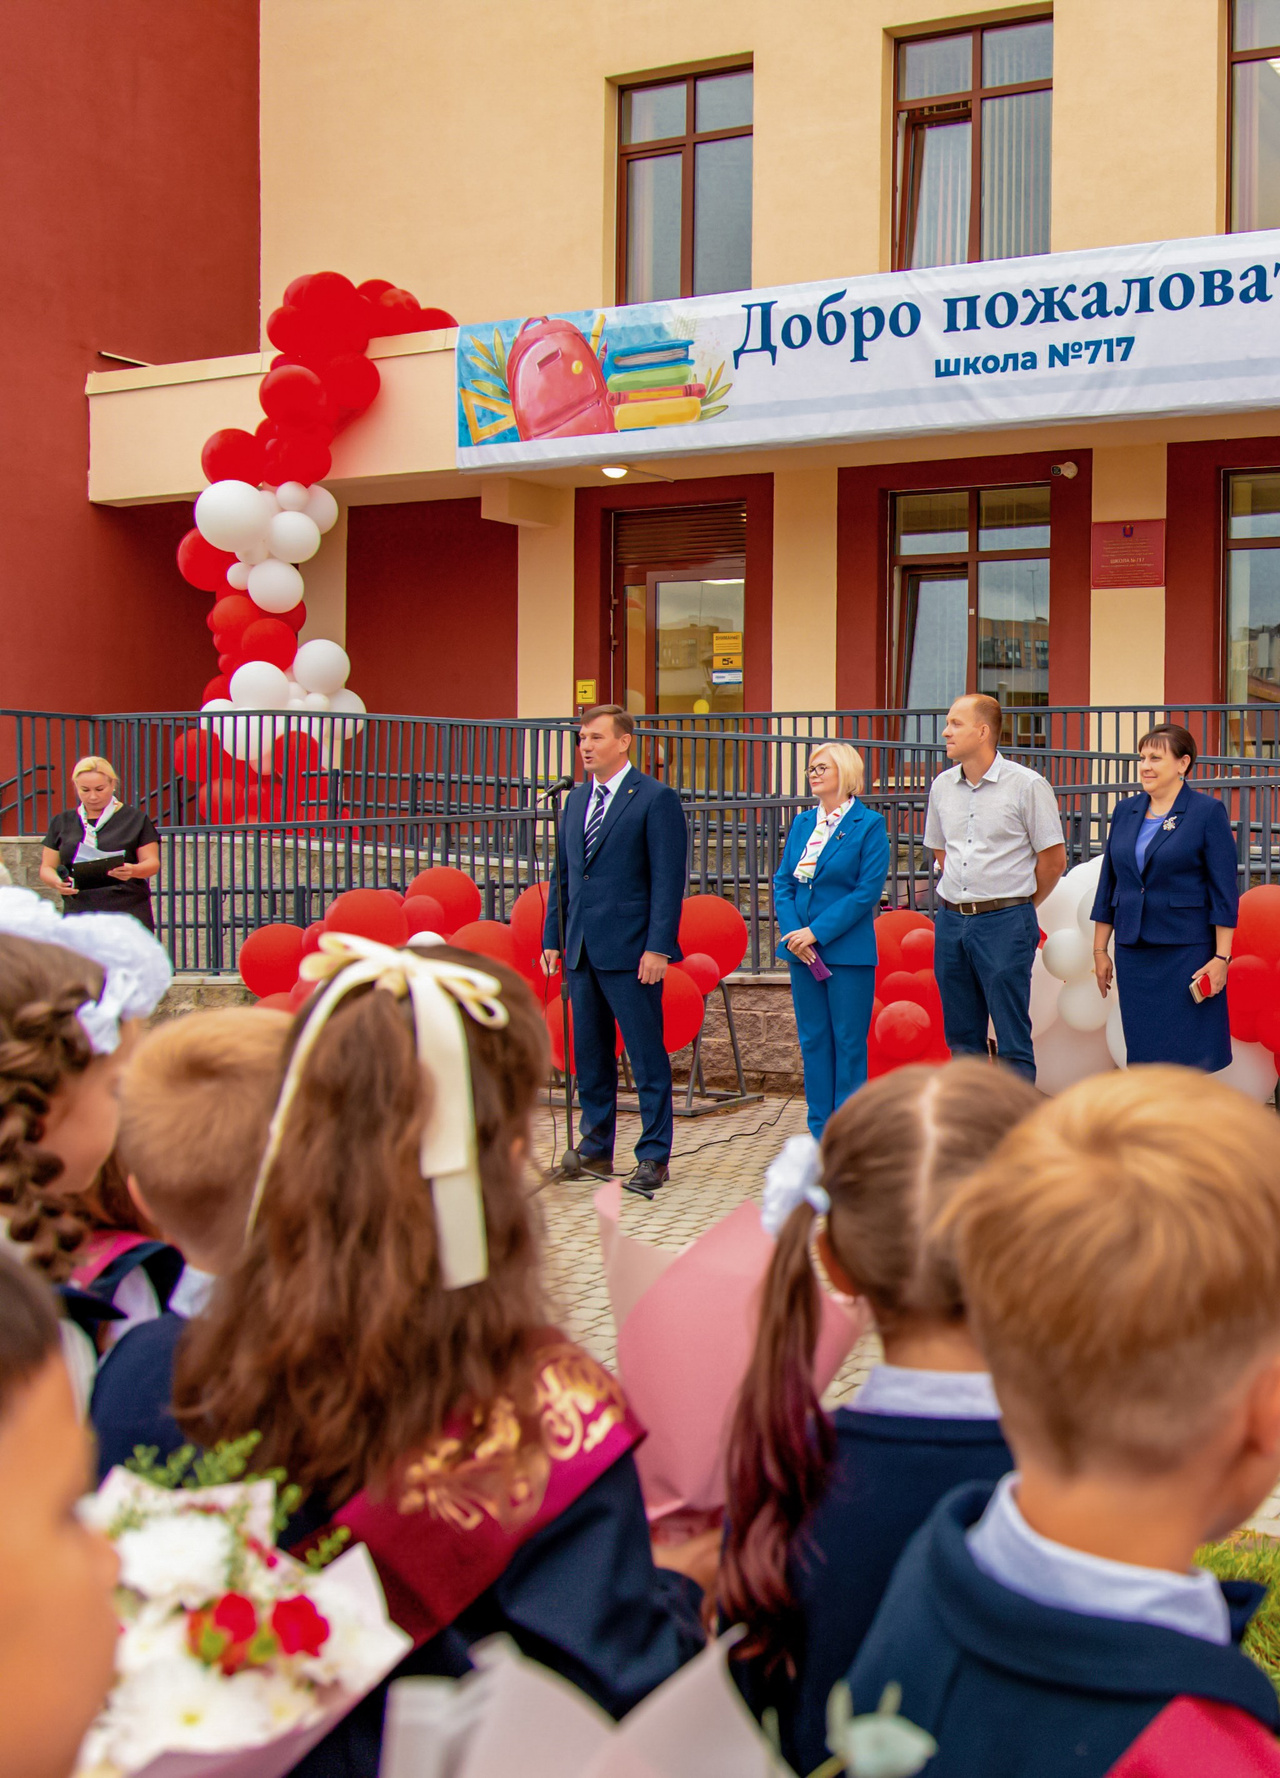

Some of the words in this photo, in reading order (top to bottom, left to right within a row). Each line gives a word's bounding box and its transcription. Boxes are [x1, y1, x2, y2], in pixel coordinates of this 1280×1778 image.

[732, 289, 921, 370] Добро
[934, 351, 1038, 378] школа
[1048, 336, 1136, 369] №717
